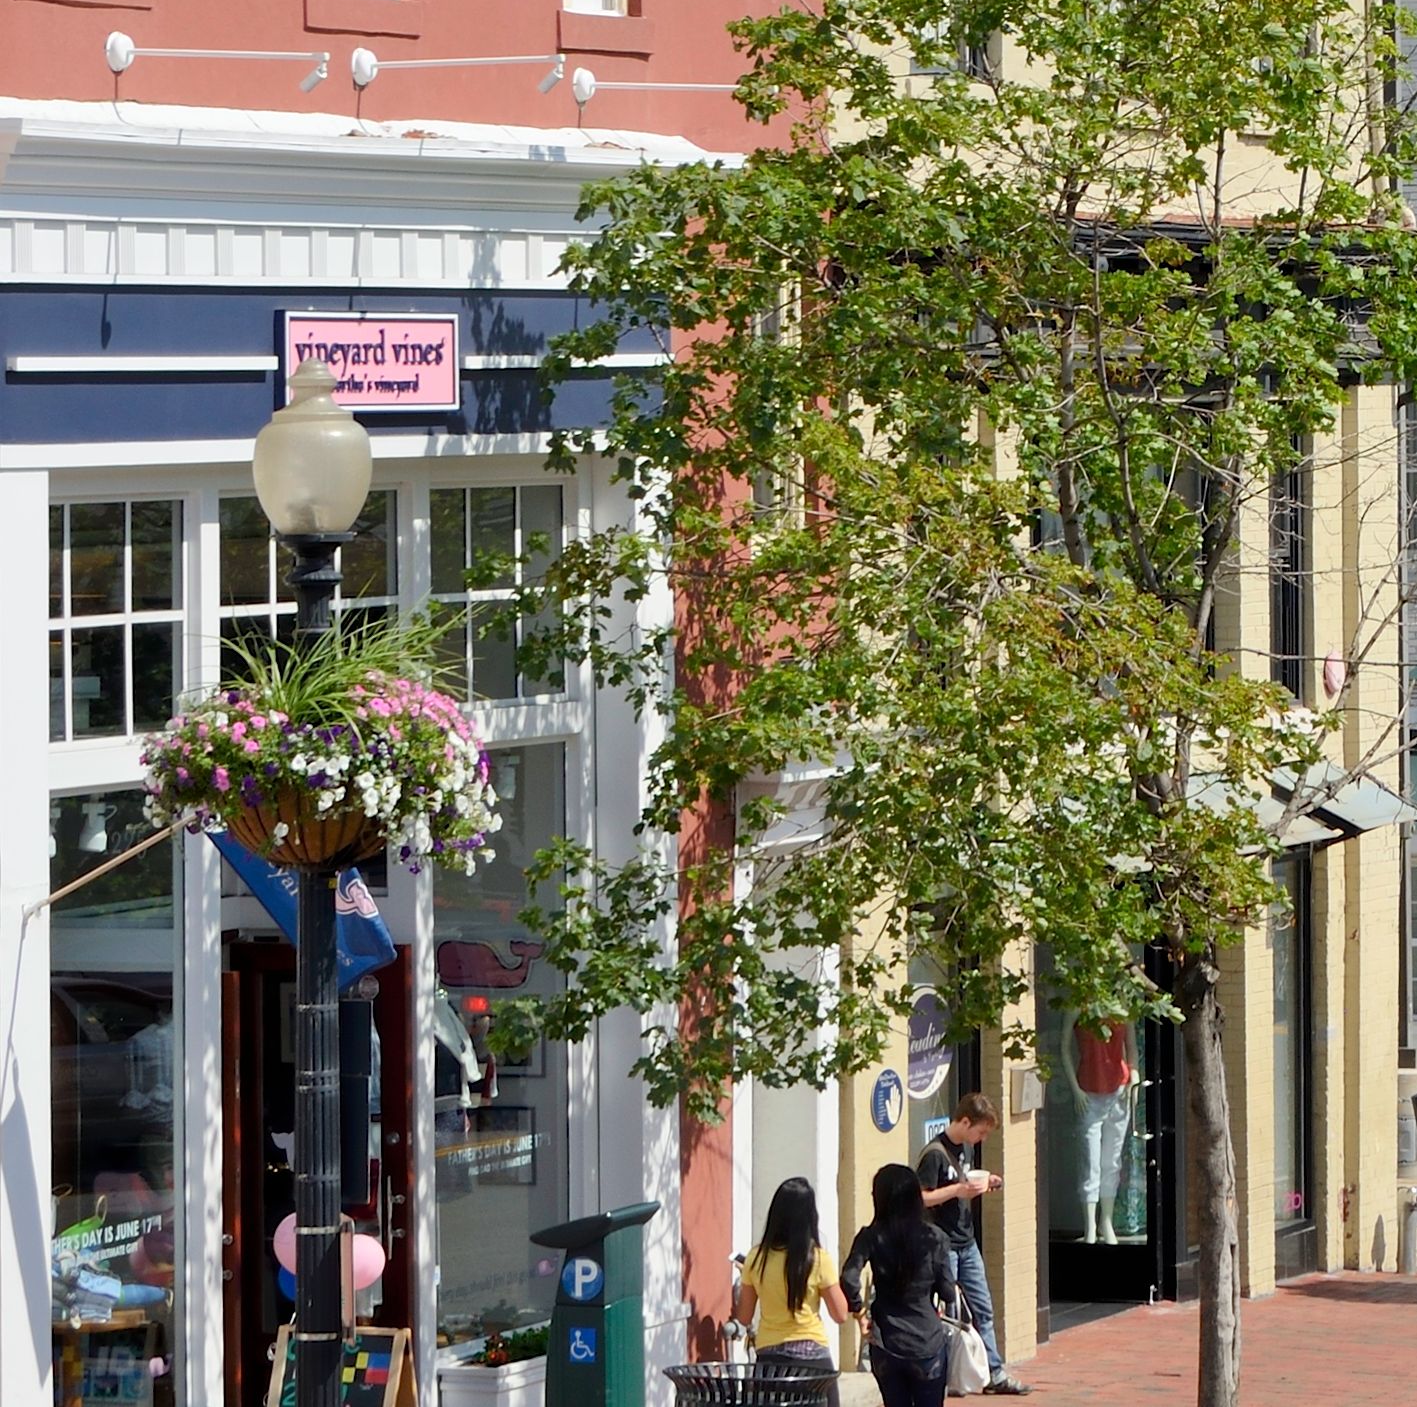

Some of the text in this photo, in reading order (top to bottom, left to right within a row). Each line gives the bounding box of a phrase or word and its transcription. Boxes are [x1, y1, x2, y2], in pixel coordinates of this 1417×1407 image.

[295, 329, 445, 378] vineyard vines
[81, 1228, 103, 1249] DAY
[104, 1225, 114, 1244] IS
[115, 1219, 140, 1242] JUNE
[575, 1259, 598, 1297] P
